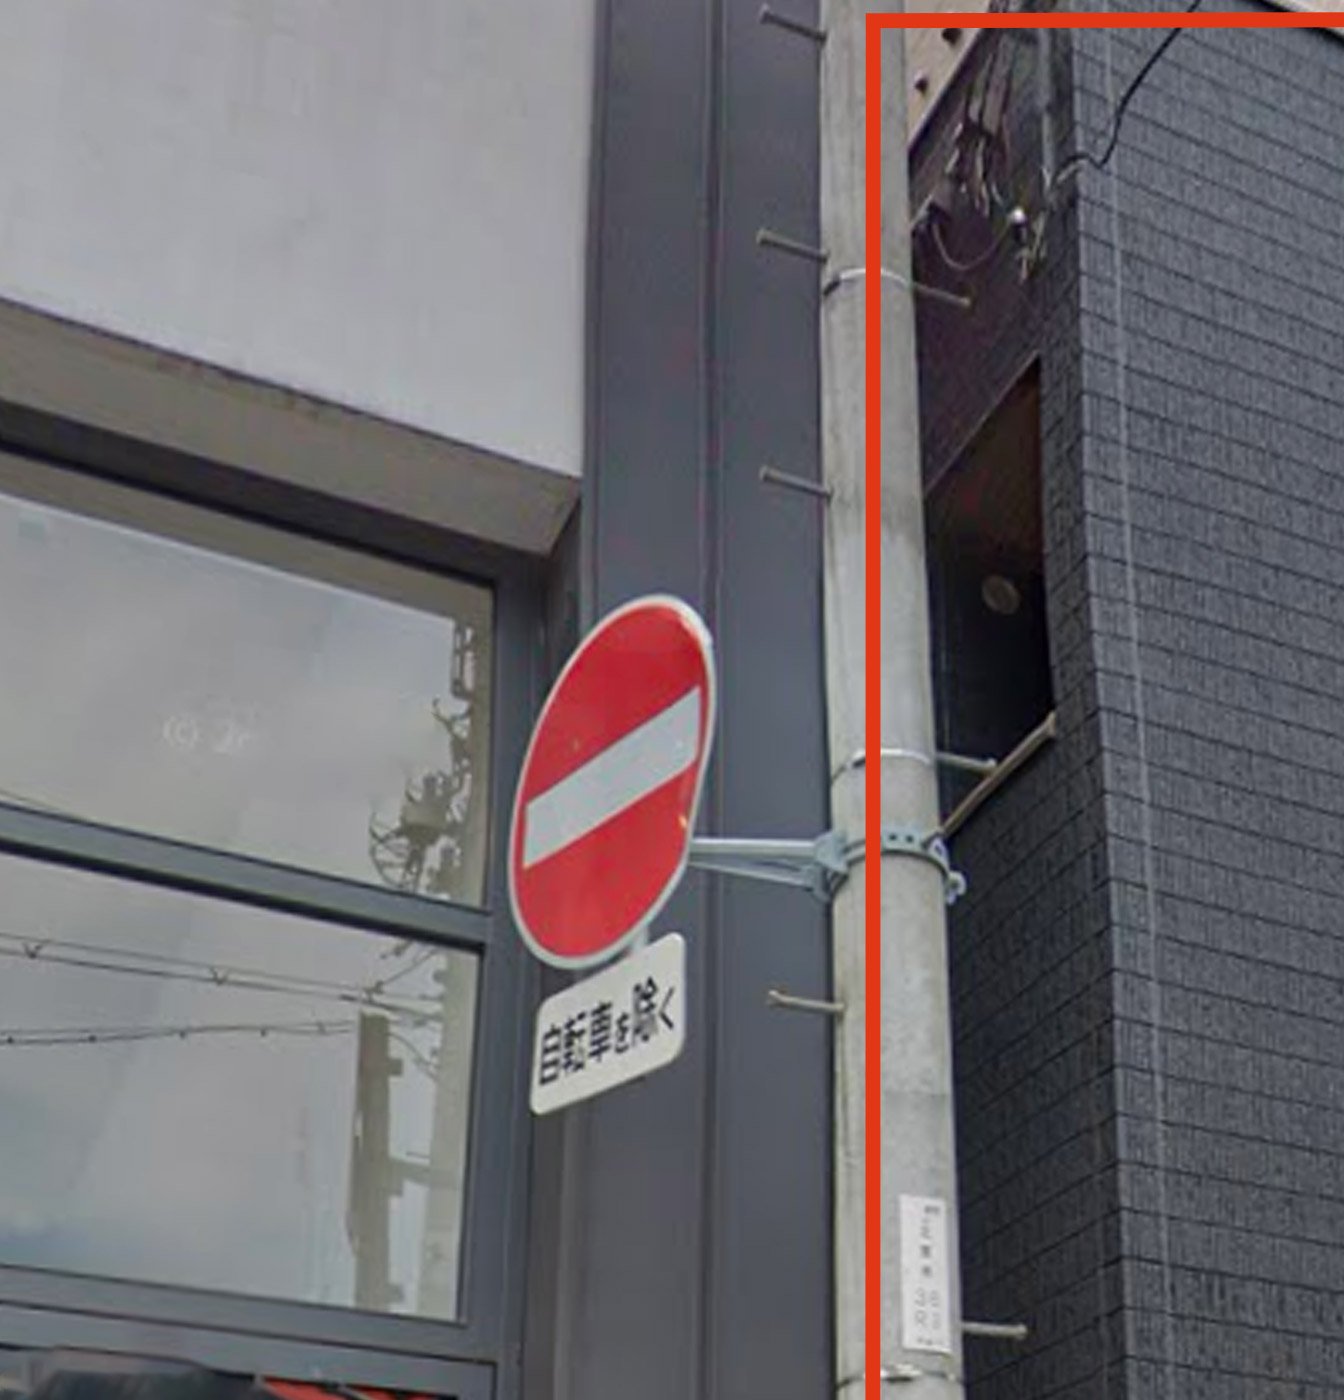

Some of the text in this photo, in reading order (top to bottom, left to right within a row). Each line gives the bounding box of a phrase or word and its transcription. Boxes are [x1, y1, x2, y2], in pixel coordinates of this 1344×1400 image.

[539, 976, 675, 1086] 自転車を除く
